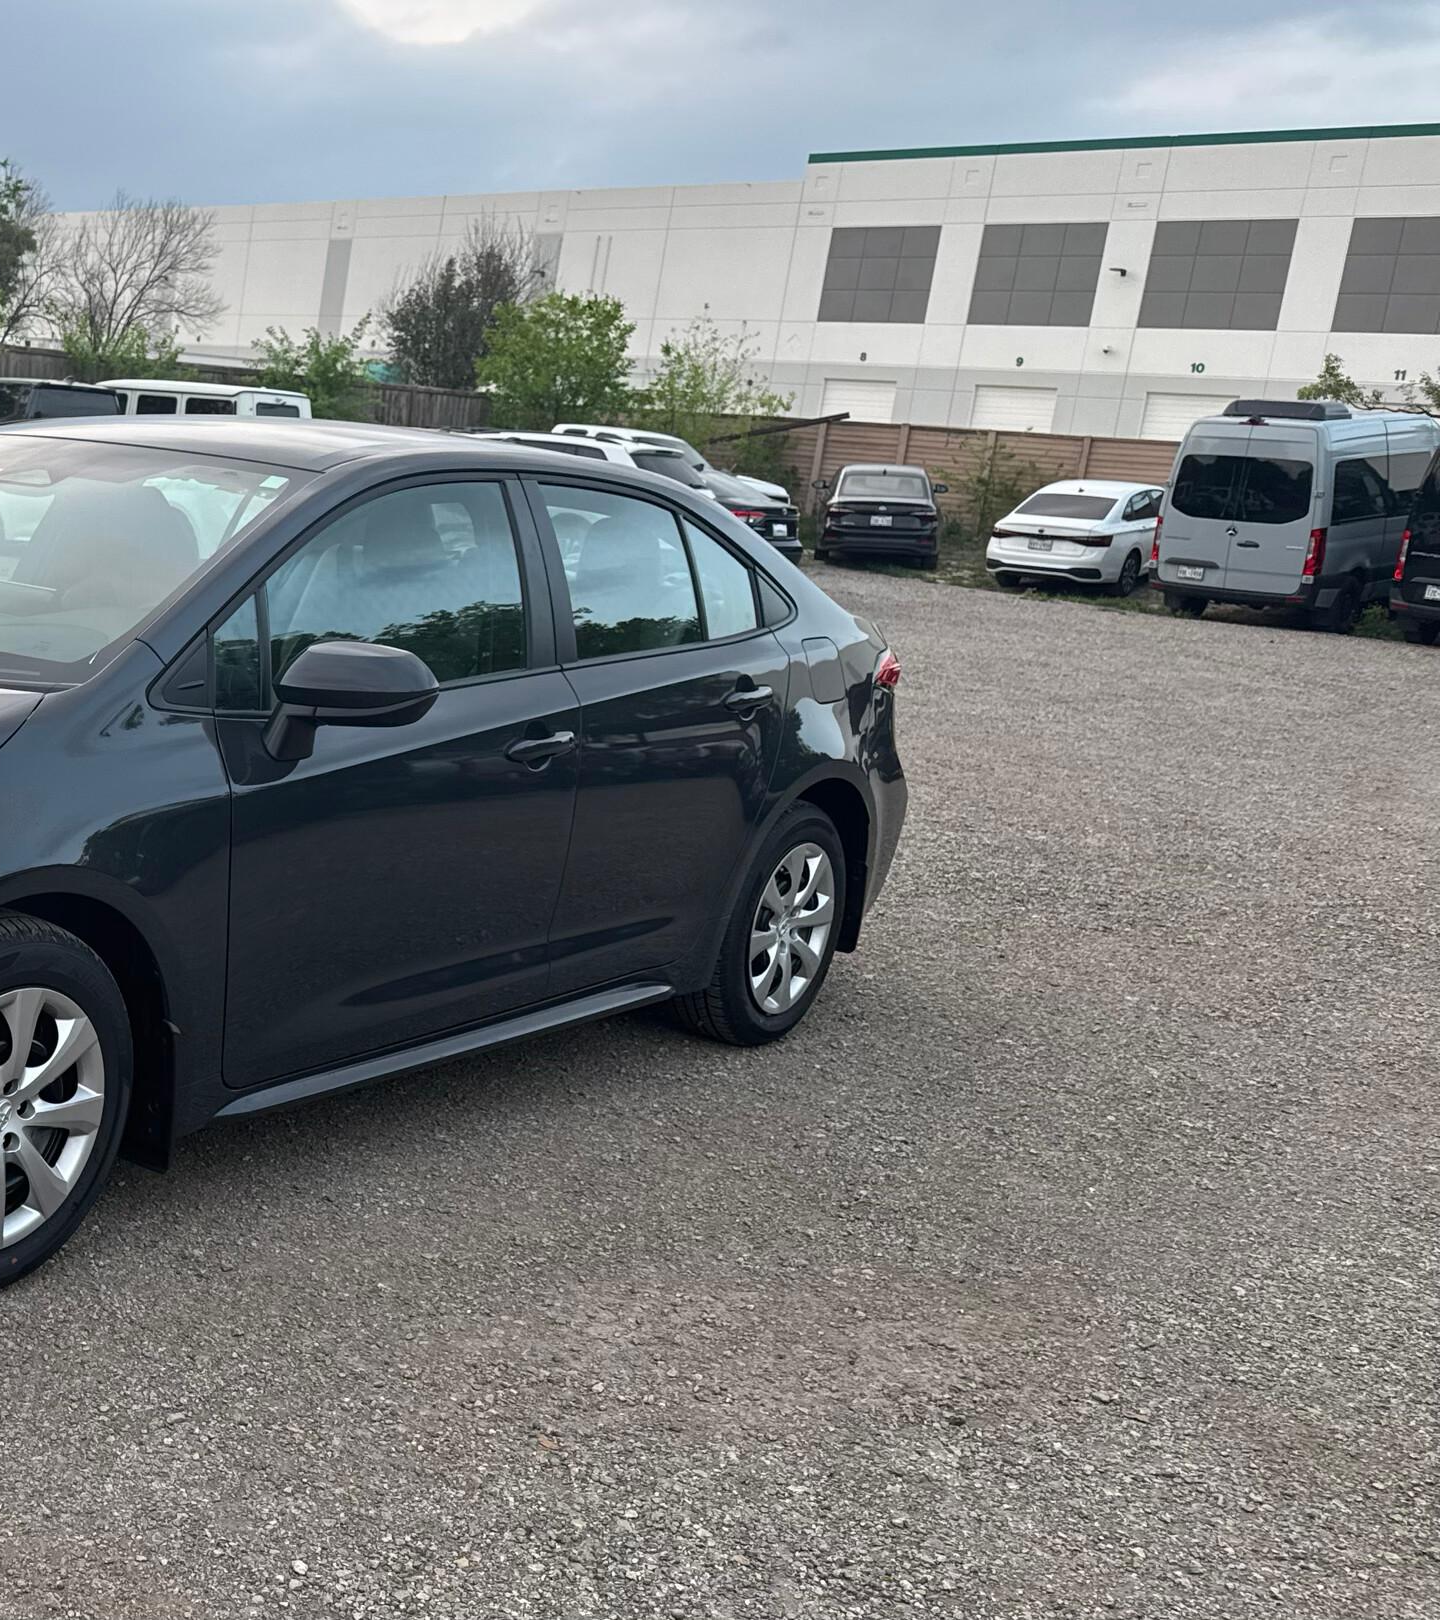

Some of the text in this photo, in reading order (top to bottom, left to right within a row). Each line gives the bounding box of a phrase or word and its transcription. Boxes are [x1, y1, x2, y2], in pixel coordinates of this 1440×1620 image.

[859, 352, 867, 362] 8
[1016, 356, 1024, 367] 9
[1190, 362, 1205, 373] 10
[1394, 369, 1407, 381] 11
